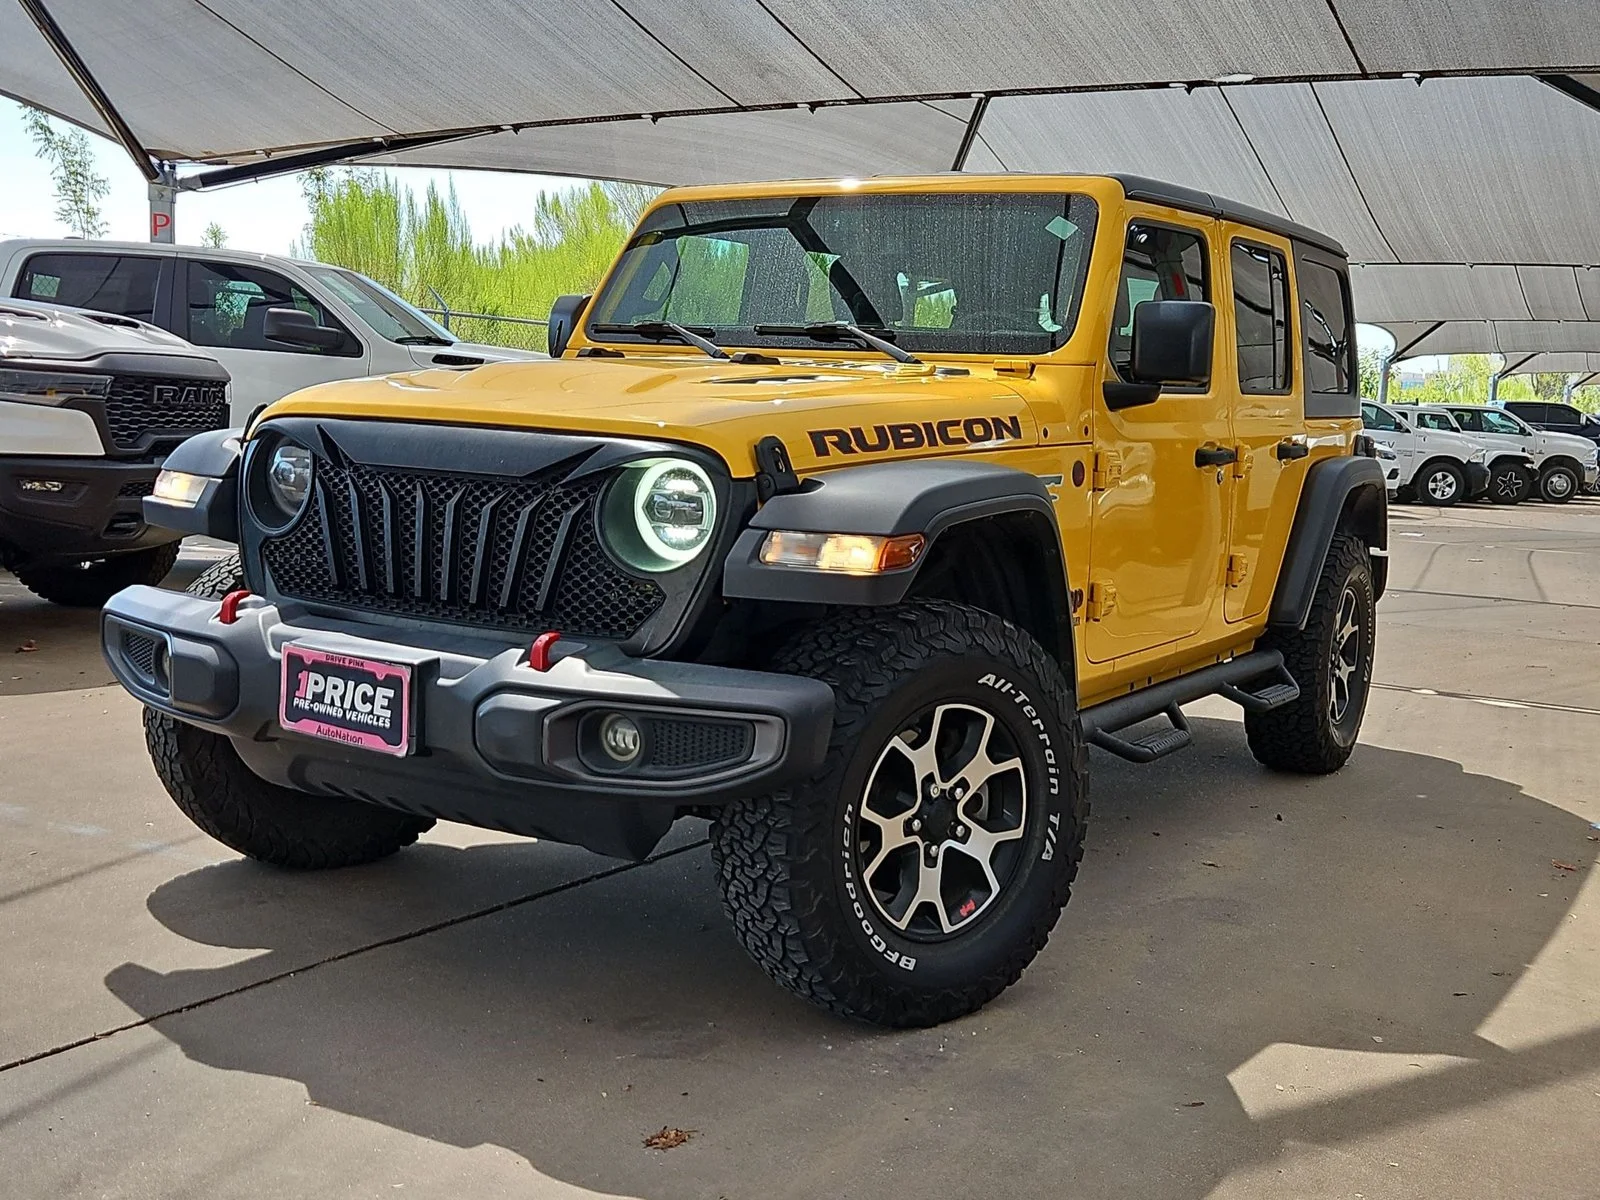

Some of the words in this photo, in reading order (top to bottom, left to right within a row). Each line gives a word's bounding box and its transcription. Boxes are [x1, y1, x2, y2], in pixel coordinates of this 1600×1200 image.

[152, 212, 172, 237] P
[153, 385, 221, 405] RAM
[807, 415, 1022, 458] RUBICON
[325, 654, 346, 665] DRIVE
[348, 657, 364, 667] PINK
[293, 697, 344, 719] PRE-OWNED
[345, 710, 392, 729] VEHICLES
[316, 725, 363, 744] AutoNation
[977, 673, 1060, 796] All-Terrain
[1041, 812, 1061, 861] T/A
[841, 804, 917, 972] BFGoodrich
